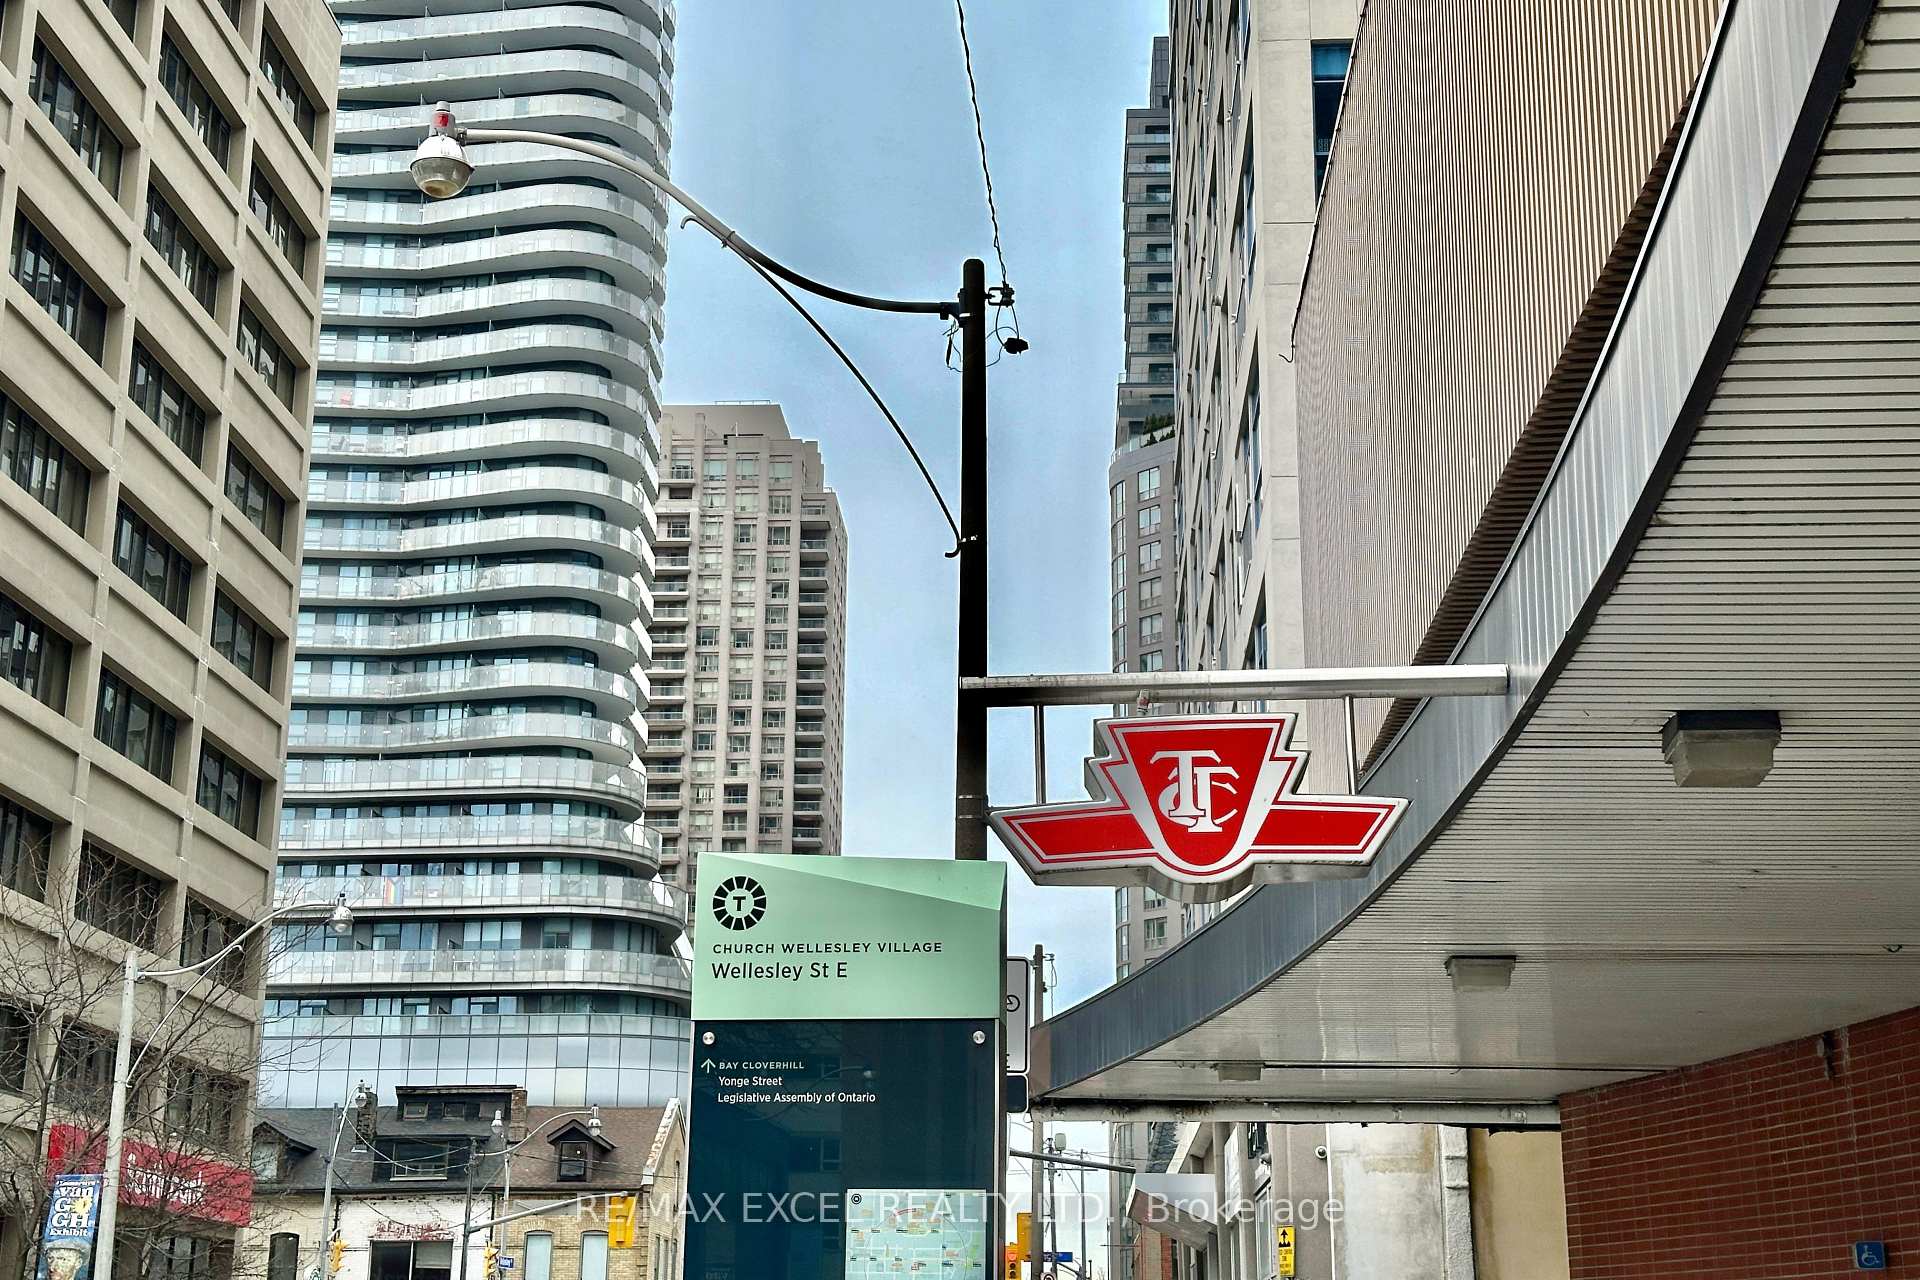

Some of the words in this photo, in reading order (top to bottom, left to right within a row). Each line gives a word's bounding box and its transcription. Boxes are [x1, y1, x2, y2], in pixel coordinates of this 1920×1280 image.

[1149, 749, 1240, 833] TTC
[732, 895, 747, 912] T
[712, 943, 775, 955] CHURCH
[781, 942, 871, 954] WELLESLEY
[877, 942, 943, 953] VILLAGE
[711, 961, 803, 981] Wellesley
[810, 961, 829, 978] St
[837, 961, 848, 978] E
[719, 1061, 739, 1070] BAY
[742, 1061, 805, 1070] CLOVERHILL
[718, 1076, 750, 1088] Yonge
[752, 1076, 783, 1087] Street
[718, 1092, 771, 1104] Legislative
[773, 1092, 823, 1104] Assembly
[824, 1092, 836, 1103] of
[837, 1092, 876, 1103] Ontario
